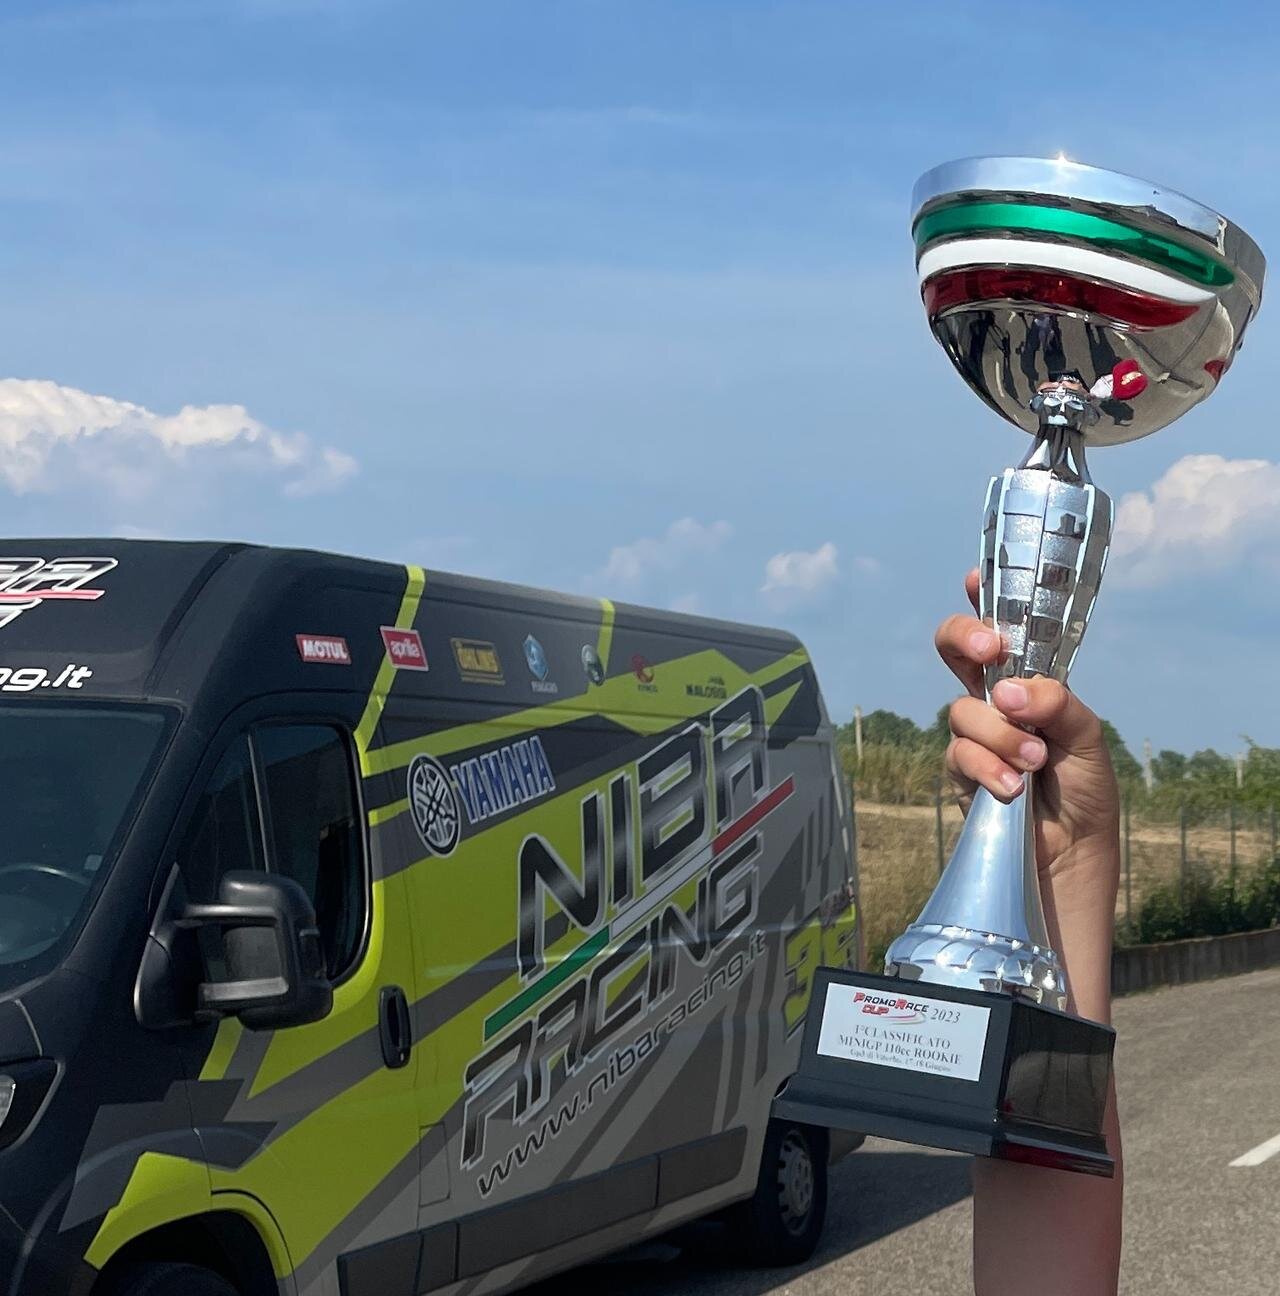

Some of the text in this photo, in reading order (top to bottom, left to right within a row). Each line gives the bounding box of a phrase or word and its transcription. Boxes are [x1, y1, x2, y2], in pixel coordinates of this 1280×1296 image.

[302, 639, 348, 659] MOTUL
[450, 735, 556, 824] YAMAHA
[518, 684, 769, 984] NIBA
[459, 829, 764, 1170] RACING
[862, 1004, 889, 1015] CUP
[930, 1008, 961, 1024] 2023
[477, 928, 767, 1199] www.nibaracing.it
[839, 1034, 882, 1053] MINIGP
[884, 1041, 911, 1057] 110cc
[914, 1048, 962, 1066] ROOKIE
